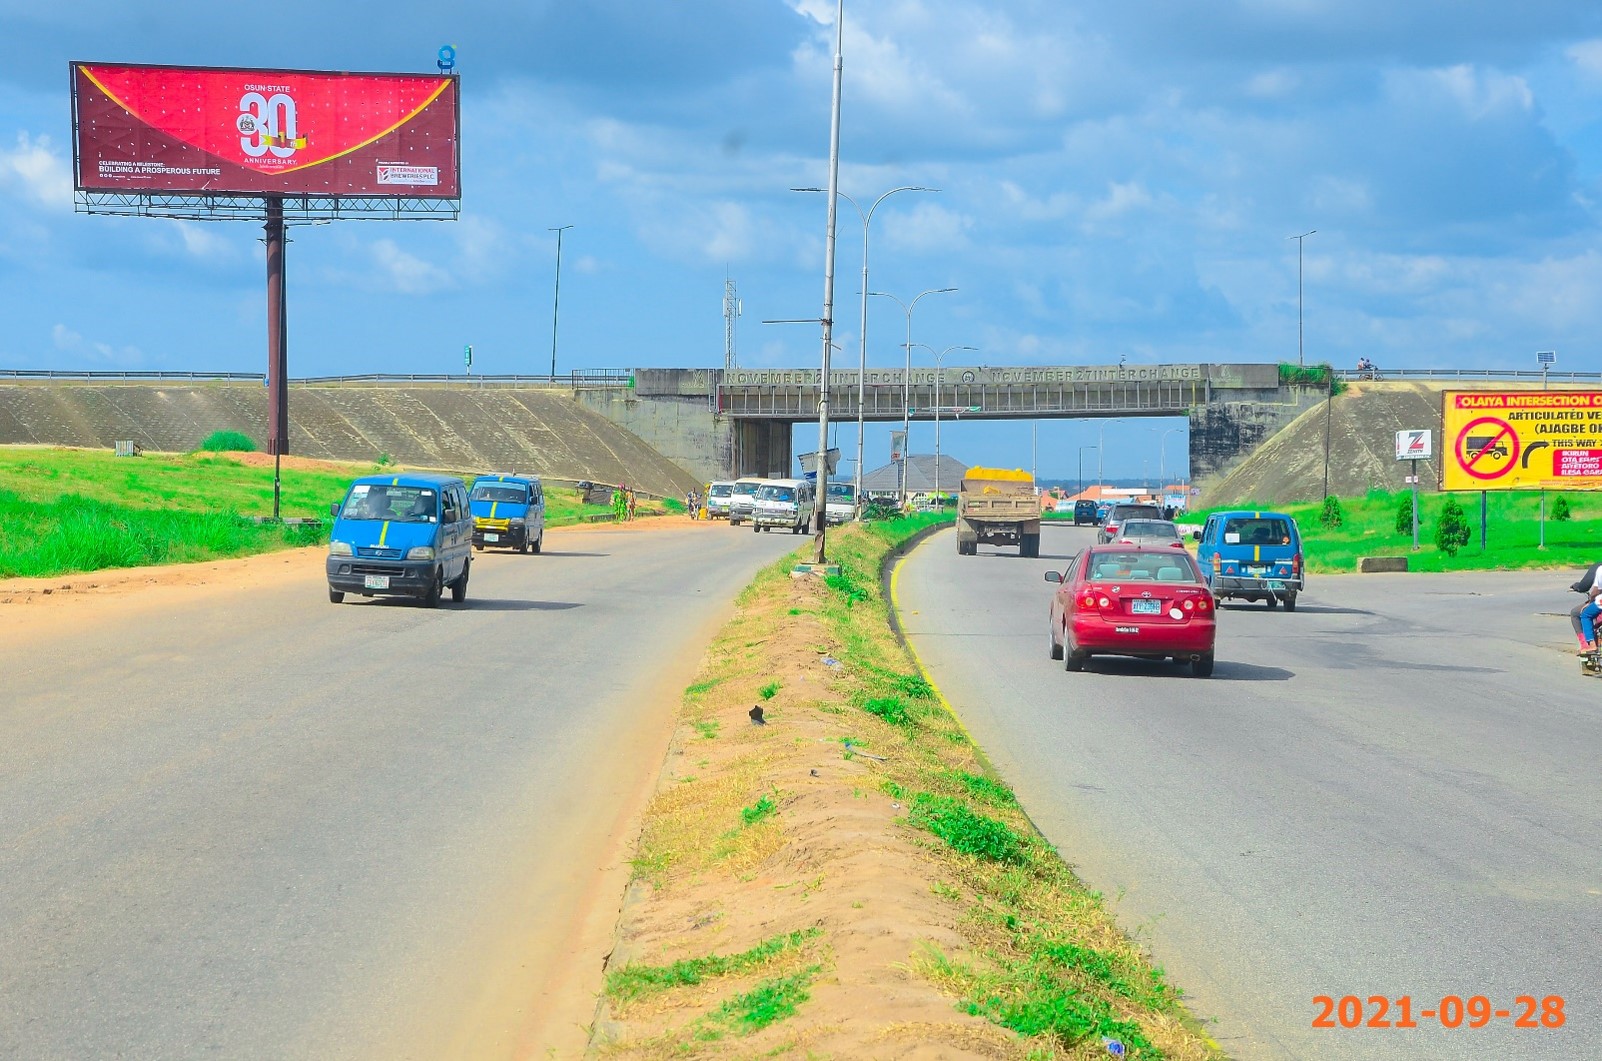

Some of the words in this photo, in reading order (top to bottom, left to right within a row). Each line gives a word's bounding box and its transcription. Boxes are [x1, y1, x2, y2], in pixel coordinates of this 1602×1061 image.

[267, 85, 290, 93] STATE
[239, 92, 296, 158] 30
[142, 167, 191, 175] PROSPEROUS
[726, 372, 812, 384] NOVEMBER
[834, 372, 945, 384] INTERCHANGE
[992, 371, 1072, 382] NOVEMBER
[1094, 368, 1198, 380] INTERCHANGE
[1461, 396, 1503, 407] OLAIYA
[1506, 395, 1589, 406] INTERSECTION
[1508, 412, 1583, 420] ARTICULATED
[1587, 412, 1602, 420] VE
[1535, 424, 1586, 434] (AJAGBE
[1552, 439, 1573, 447] THIS
[1576, 439, 1596, 447] WAY
